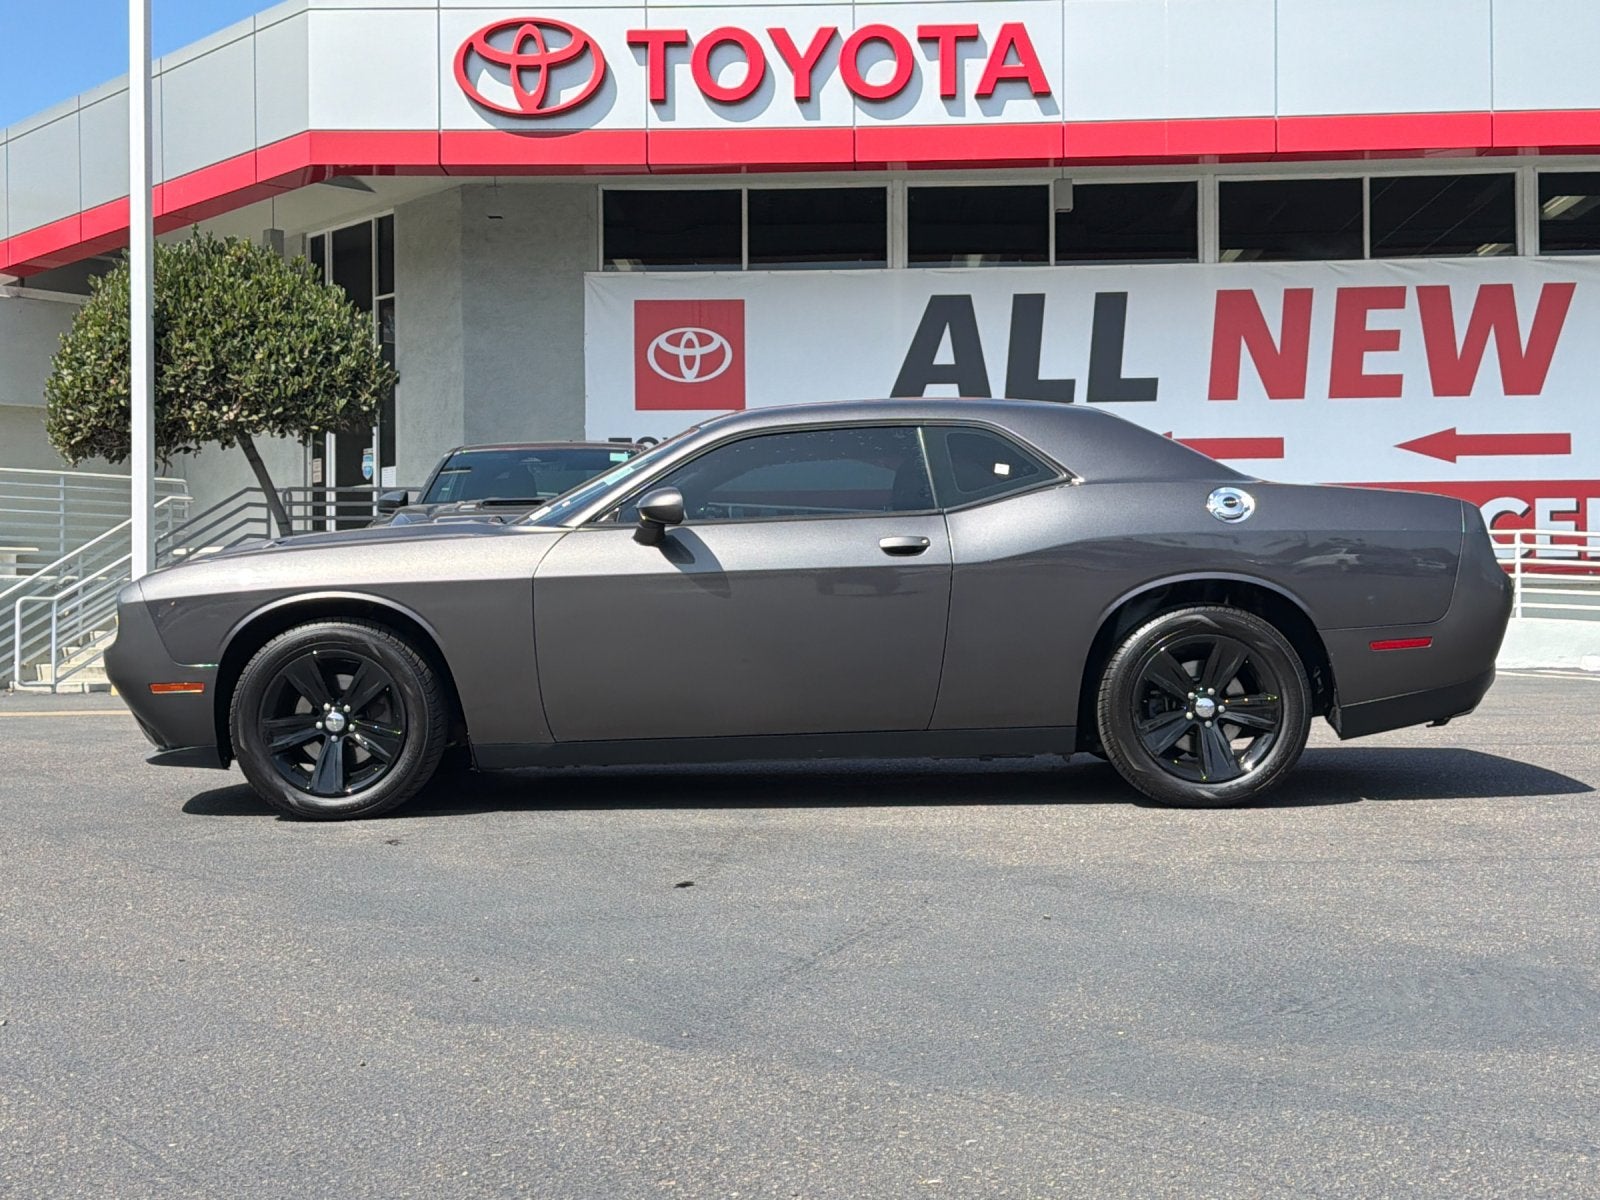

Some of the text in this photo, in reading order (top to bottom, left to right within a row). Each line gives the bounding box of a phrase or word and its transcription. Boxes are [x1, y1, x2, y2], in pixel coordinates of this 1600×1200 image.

[626, 22, 1052, 103] TOYOTA
[890, 282, 1577, 402] ALL NEW
